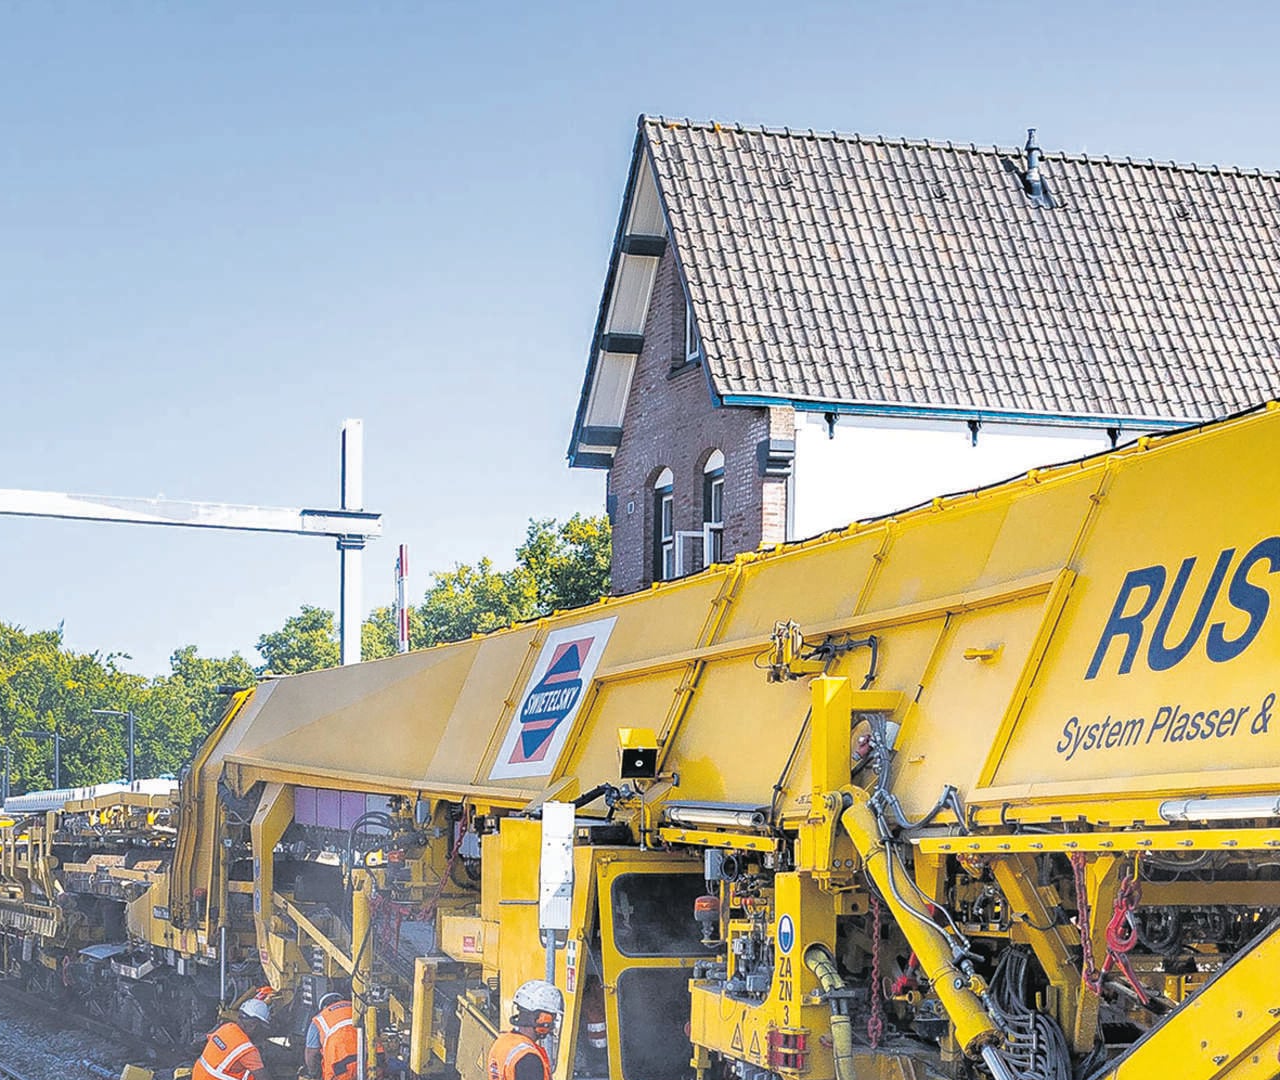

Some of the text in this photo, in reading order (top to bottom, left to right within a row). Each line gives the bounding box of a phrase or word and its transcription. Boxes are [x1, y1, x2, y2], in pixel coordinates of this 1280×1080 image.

[523, 686, 579, 716] SWIETELSKY
[1056, 716, 1145, 762] System
[1144, 703, 1252, 746] Plasser
[1250, 700, 1273, 736] &
[779, 957, 792, 978] ZA
[779, 980, 793, 1002] ZN
[783, 1005, 790, 1025] 3
